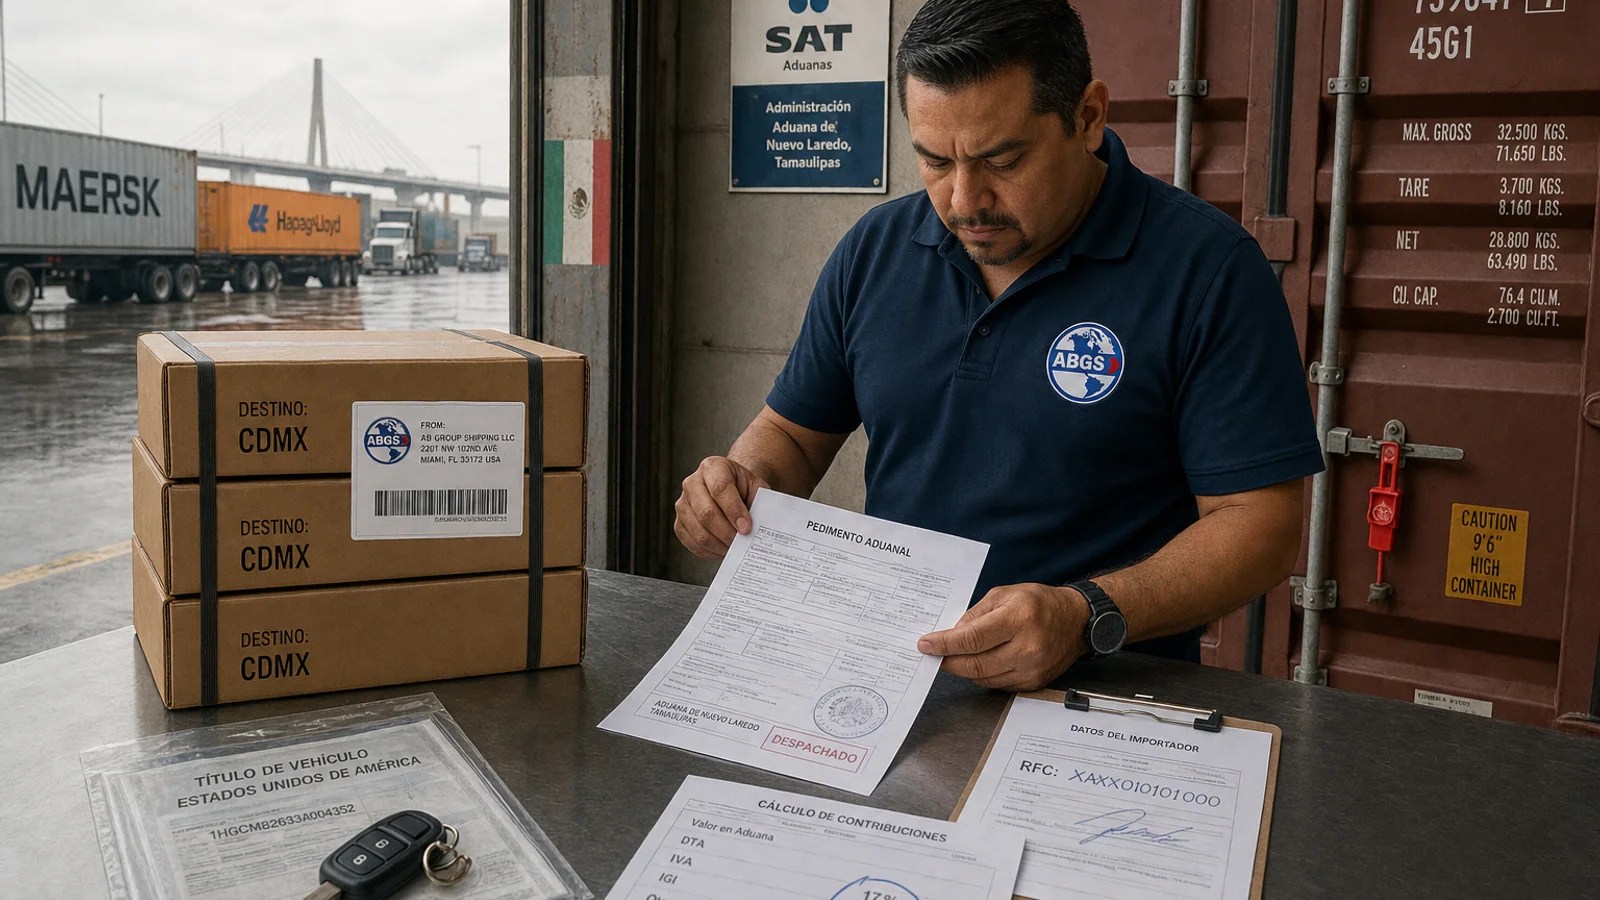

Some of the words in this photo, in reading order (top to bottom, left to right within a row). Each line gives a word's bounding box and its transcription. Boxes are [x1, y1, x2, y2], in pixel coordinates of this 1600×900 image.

[766, 24, 852, 53] SAT
[1409, 26, 1472, 60] 45G1
[783, 60, 832, 71] Aduanas
[766, 100, 851, 113] Administración
[773, 121, 817, 133] Aduana
[1402, 123, 1430, 141] MAX.
[1433, 123, 1472, 141] GROSS
[1497, 124, 1537, 140] 32.500
[1543, 124, 1568, 140] KGS.
[766, 139, 803, 151] Nuevo
[807, 138, 851, 152] Laredo,
[1496, 145, 1536, 161] 71.650
[1541, 145, 1566, 161] LBS.
[775, 156, 841, 171] Tamaulipas
[16, 164, 161, 217] MAERSK
[1399, 178, 1430, 197] TARE
[1500, 178, 1533, 194] 3.700
[1539, 178, 1564, 194] KGS.
[1498, 199, 1531, 216] 8.160
[1537, 200, 1562, 216] LBS.
[1396, 231, 1420, 250] NET
[1489, 232, 1529, 249] 28.800
[1535, 232, 1560, 249] KGS.
[1487, 253, 1527, 270] 63.490
[1533, 254, 1558, 271] LBS.
[1392, 286, 1410, 305] CU.
[1414, 286, 1439, 306] CAP.
[1499, 287, 1524, 305] 76.4
[1530, 289, 1561, 306] CU.M.
[1487, 308, 1520, 325] 2.700
[1526, 310, 1559, 327] CU.FT.
[1052, 352, 1105, 371] ABGS
[239, 401, 308, 417] DESTINO:
[420, 421, 446, 429] FROM:
[239, 426, 309, 454] CDMX
[367, 435, 401, 446] ABGS
[420, 434, 432, 442] AB
[434, 434, 462, 442] GROUP
[463, 434, 500, 442] SHIPPING
[501, 434, 515, 442] LLC
[420, 456, 446, 464] MIAMI,
[240, 518, 309, 536] DESTINO:
[1461, 509, 1517, 532] CAUTION
[806, 520, 863, 544] PEDIMENTO
[864, 537, 912, 557] ADUANAL
[241, 544, 310, 572] CDMX
[1470, 556, 1500, 577] HIGH
[1451, 576, 1517, 601] CONTAINER
[241, 628, 309, 648] DESTINO:
[241, 652, 310, 681] CDMX
[654, 700, 688, 713] ADUANA
[728, 718, 760, 731] LAREDO
[1070, 724, 1104, 737] DATOS
[1107, 731, 1127, 741] DEL
[1129, 734, 1200, 753] IMPORTADOR
[771, 734, 858, 764] DESPACHADO
[194, 768, 256, 787] TÍTULO
[262, 763, 285, 776] DE
[289, 749, 368, 771] VEHÍCULO
[1019, 760, 1059, 777] RFC:
[178, 785, 257, 808] ESTADOS
[263, 773, 324, 792] UNIDOS
[329, 768, 350, 780] DE
[355, 756, 421, 776] AMÉRICA
[692, 818, 718, 831] Valor
[719, 825, 733, 834] en
[734, 827, 774, 841] Aduana
[758, 798, 816, 818] CÁLCULO
[818, 811, 834, 821] DE
[837, 815, 947, 843] CONTRIBUCIONES
[681, 835, 705, 848] DTA
[670, 854, 692, 866] IVA
[658, 872, 678, 884] IGI
